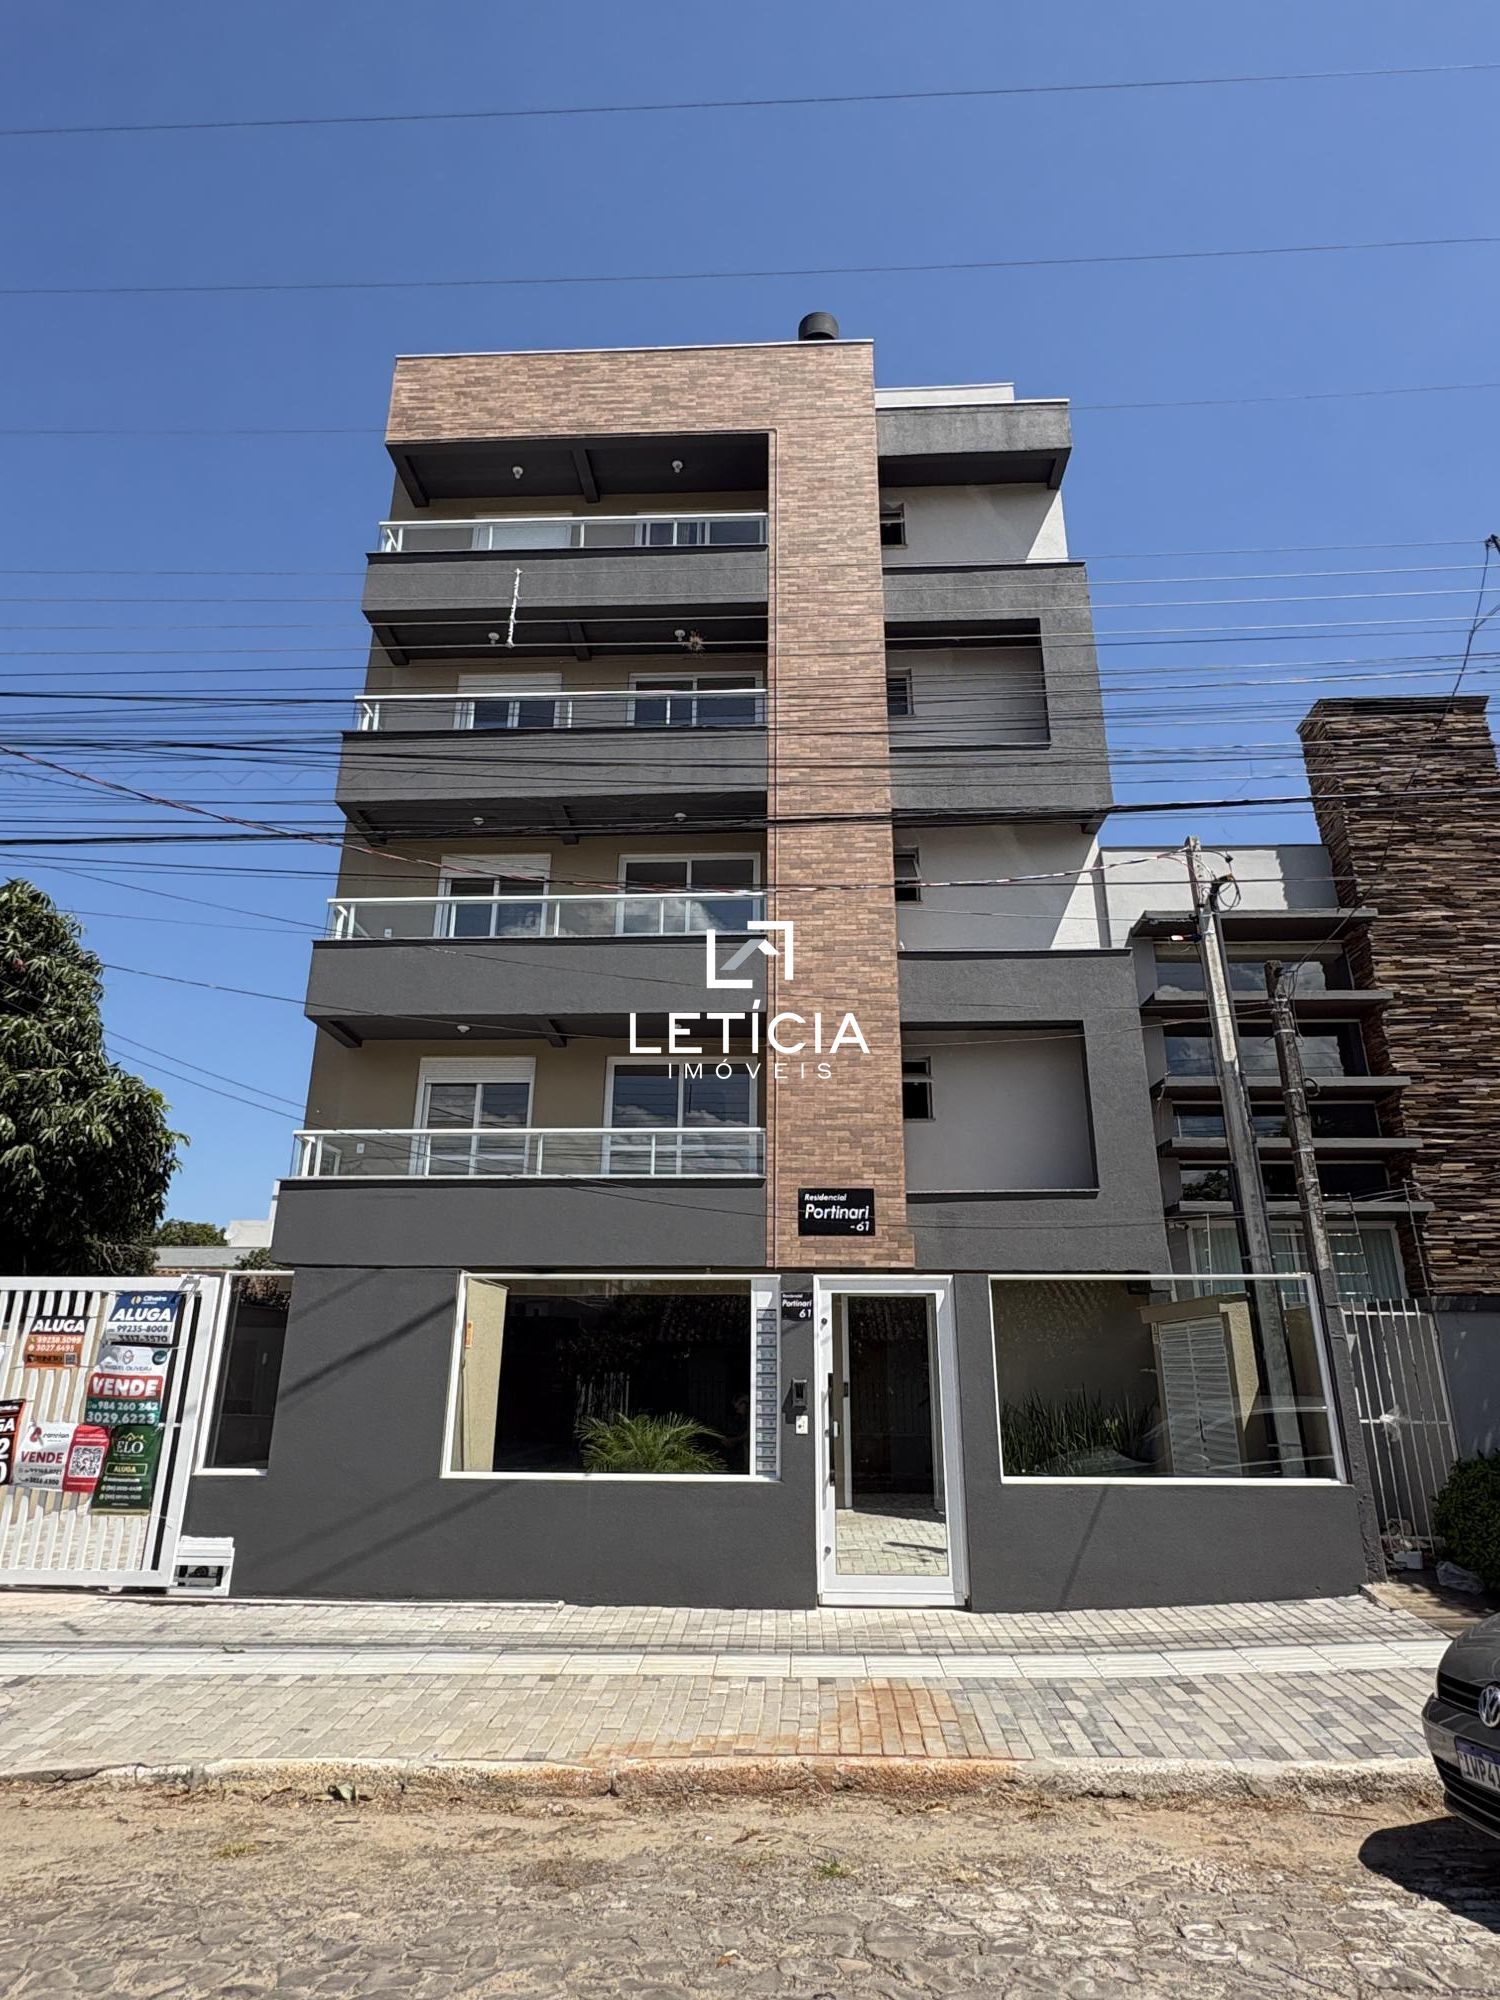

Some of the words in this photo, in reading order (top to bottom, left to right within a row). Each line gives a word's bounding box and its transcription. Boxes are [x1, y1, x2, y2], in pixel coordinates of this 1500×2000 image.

[804, 1193, 847, 1201] Residencial
[805, 1203, 869, 1219] Portinari
[782, 1299, 812, 1308] Portinari
[111, 1307, 171, 1321] ALUGA
[799, 1309, 812, 1318] 61
[31, 1319, 85, 1332] ALUGA
[93, 1377, 159, 1396] VENDE
[117, 1402, 136, 1411] 260
[86, 1411, 156, 1424] 3029.6223
[116, 1440, 144, 1454] ELO
[21, 1451, 64, 1464] VENDE
[113, 1465, 136, 1473] ALUGA
